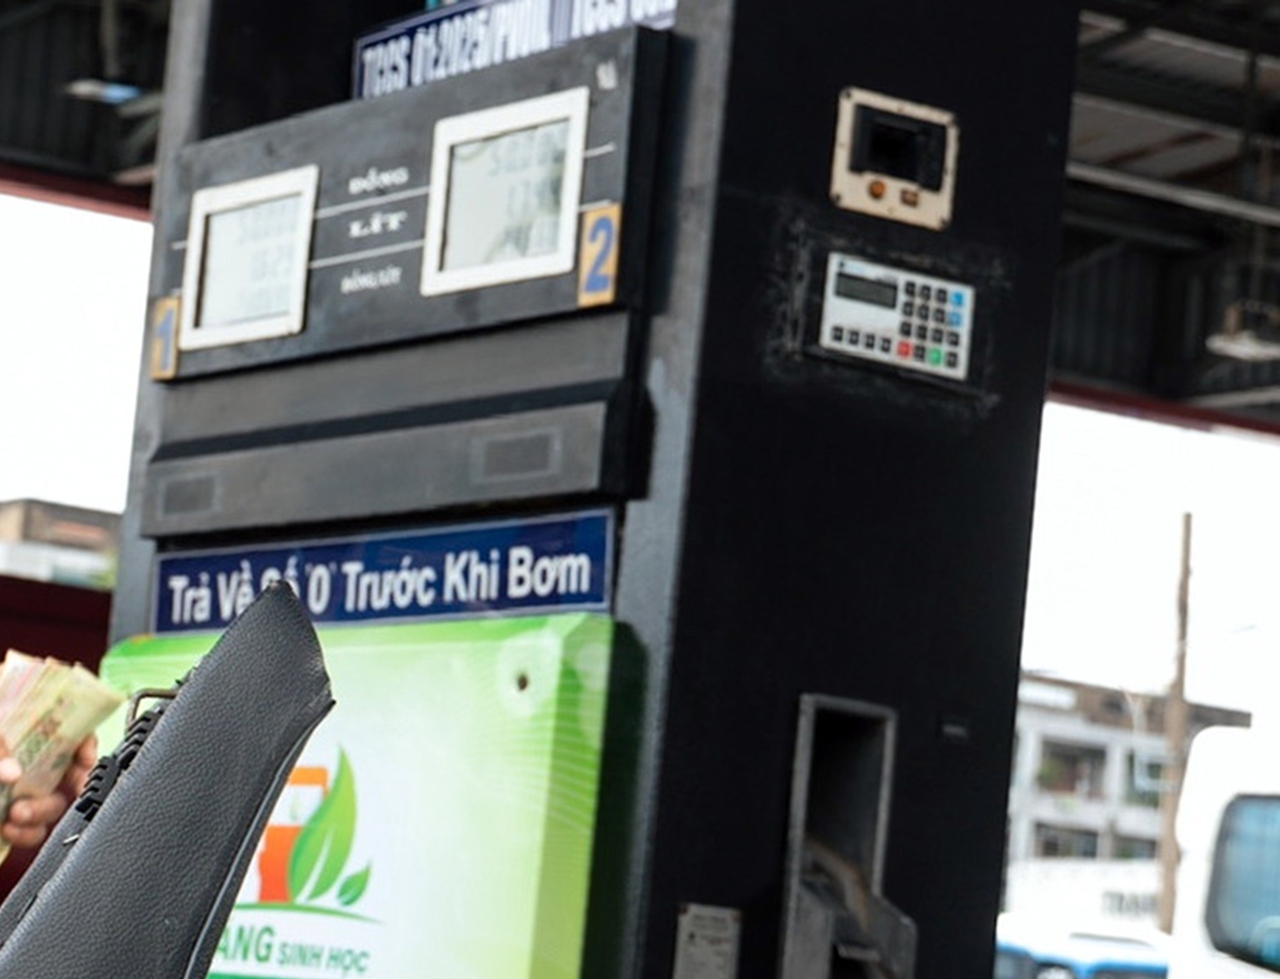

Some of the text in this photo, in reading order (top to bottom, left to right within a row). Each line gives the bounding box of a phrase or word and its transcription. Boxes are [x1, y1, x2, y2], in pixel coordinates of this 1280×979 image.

[585, 216, 614, 294] 2
[158, 308, 175, 371] 1
[168, 571, 211, 625] Trả
[217, 558, 255, 620] Về
[341, 555, 437, 613] Trước
[444, 548, 500, 603] Khi
[507, 546, 591, 599] Bơm
[219, 924, 369, 977] ANG SINH HỌC
